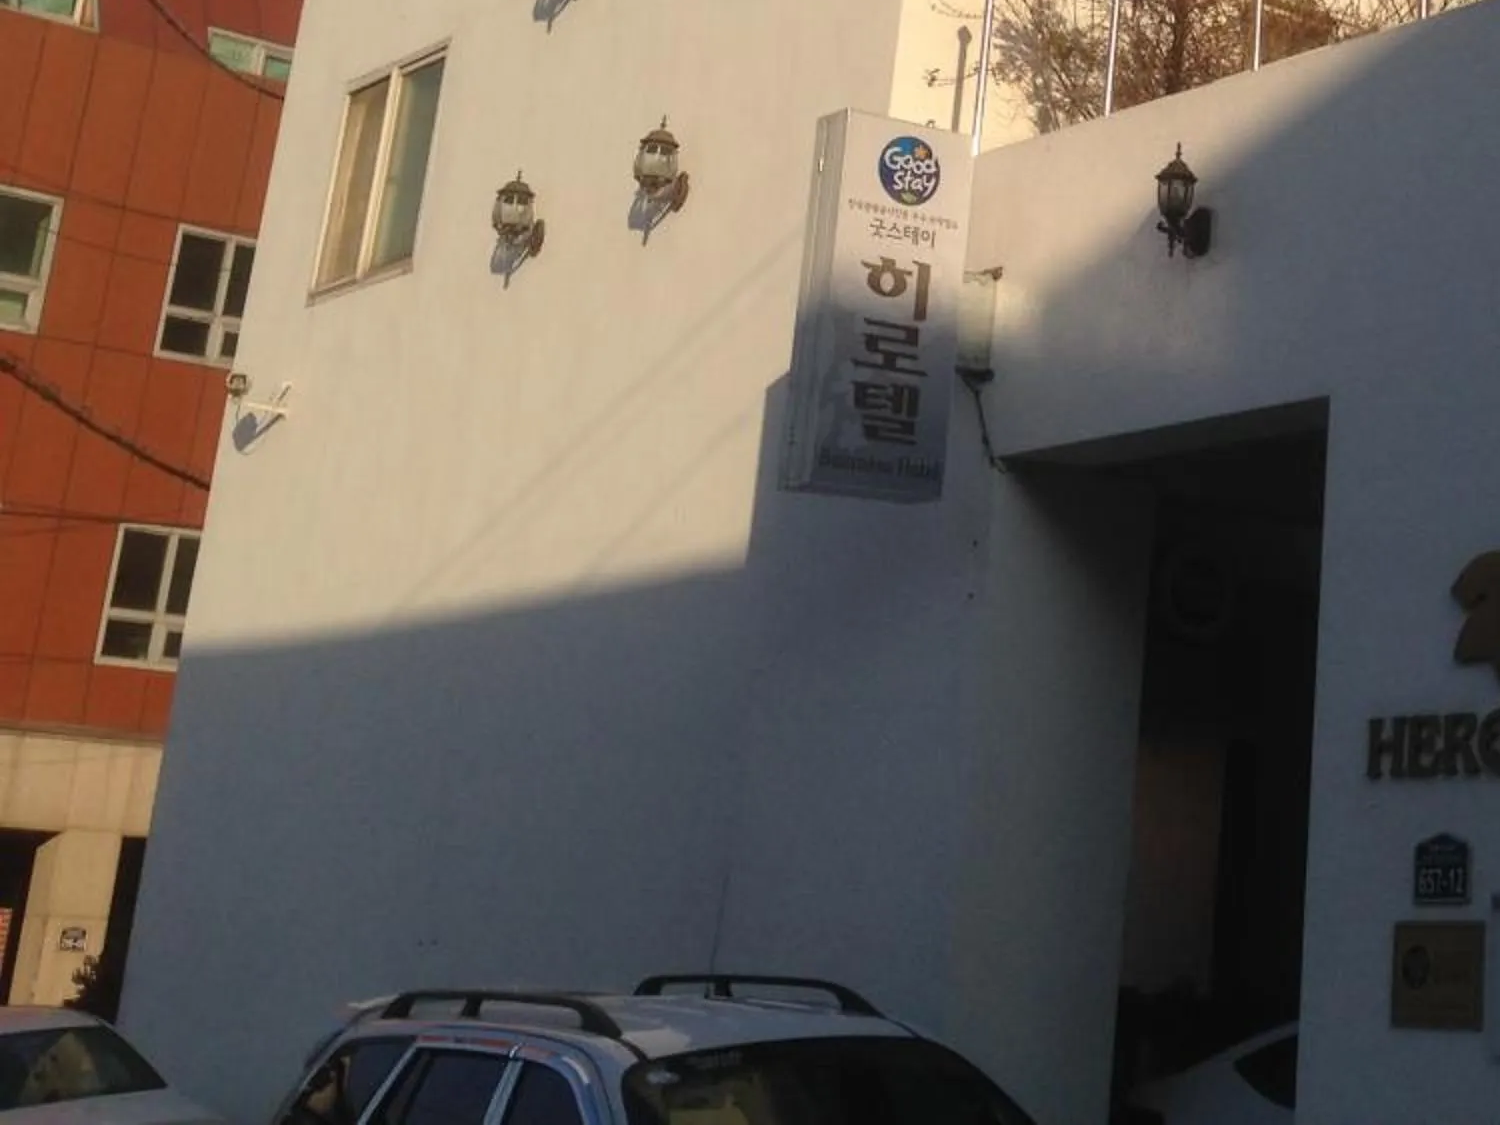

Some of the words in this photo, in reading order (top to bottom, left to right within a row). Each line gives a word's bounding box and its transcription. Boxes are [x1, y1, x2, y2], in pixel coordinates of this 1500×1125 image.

[884, 146, 938, 175] Good
[893, 171, 937, 198] Stay
[869, 217, 937, 249] 굿스테이
[850, 255, 932, 445] 히로텔
